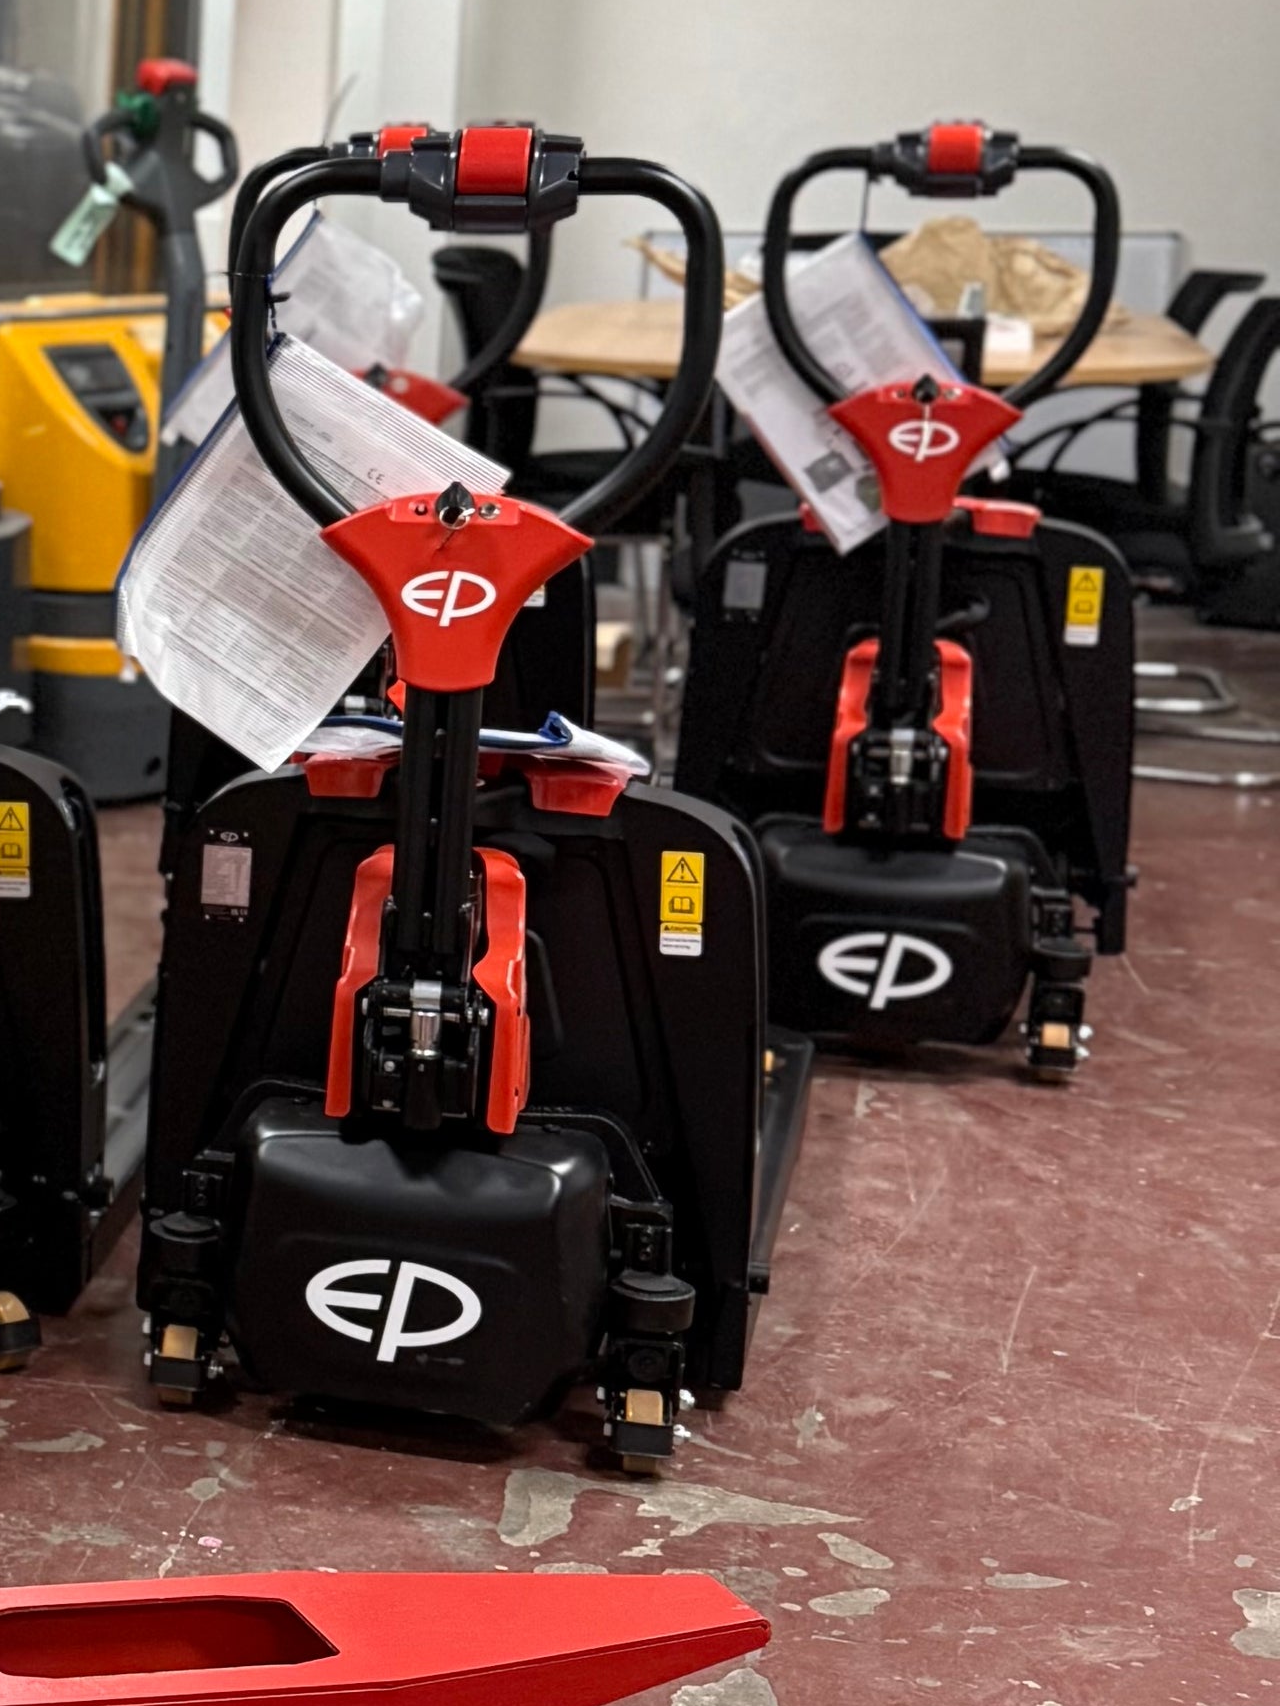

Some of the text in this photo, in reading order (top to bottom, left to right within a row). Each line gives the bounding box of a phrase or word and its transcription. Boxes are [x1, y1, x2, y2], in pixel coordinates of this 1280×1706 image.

[889, 419, 960, 462] EP
[401, 570, 497, 627] EP
[818, 933, 952, 1010] EP
[305, 1259, 482, 1362] EP
